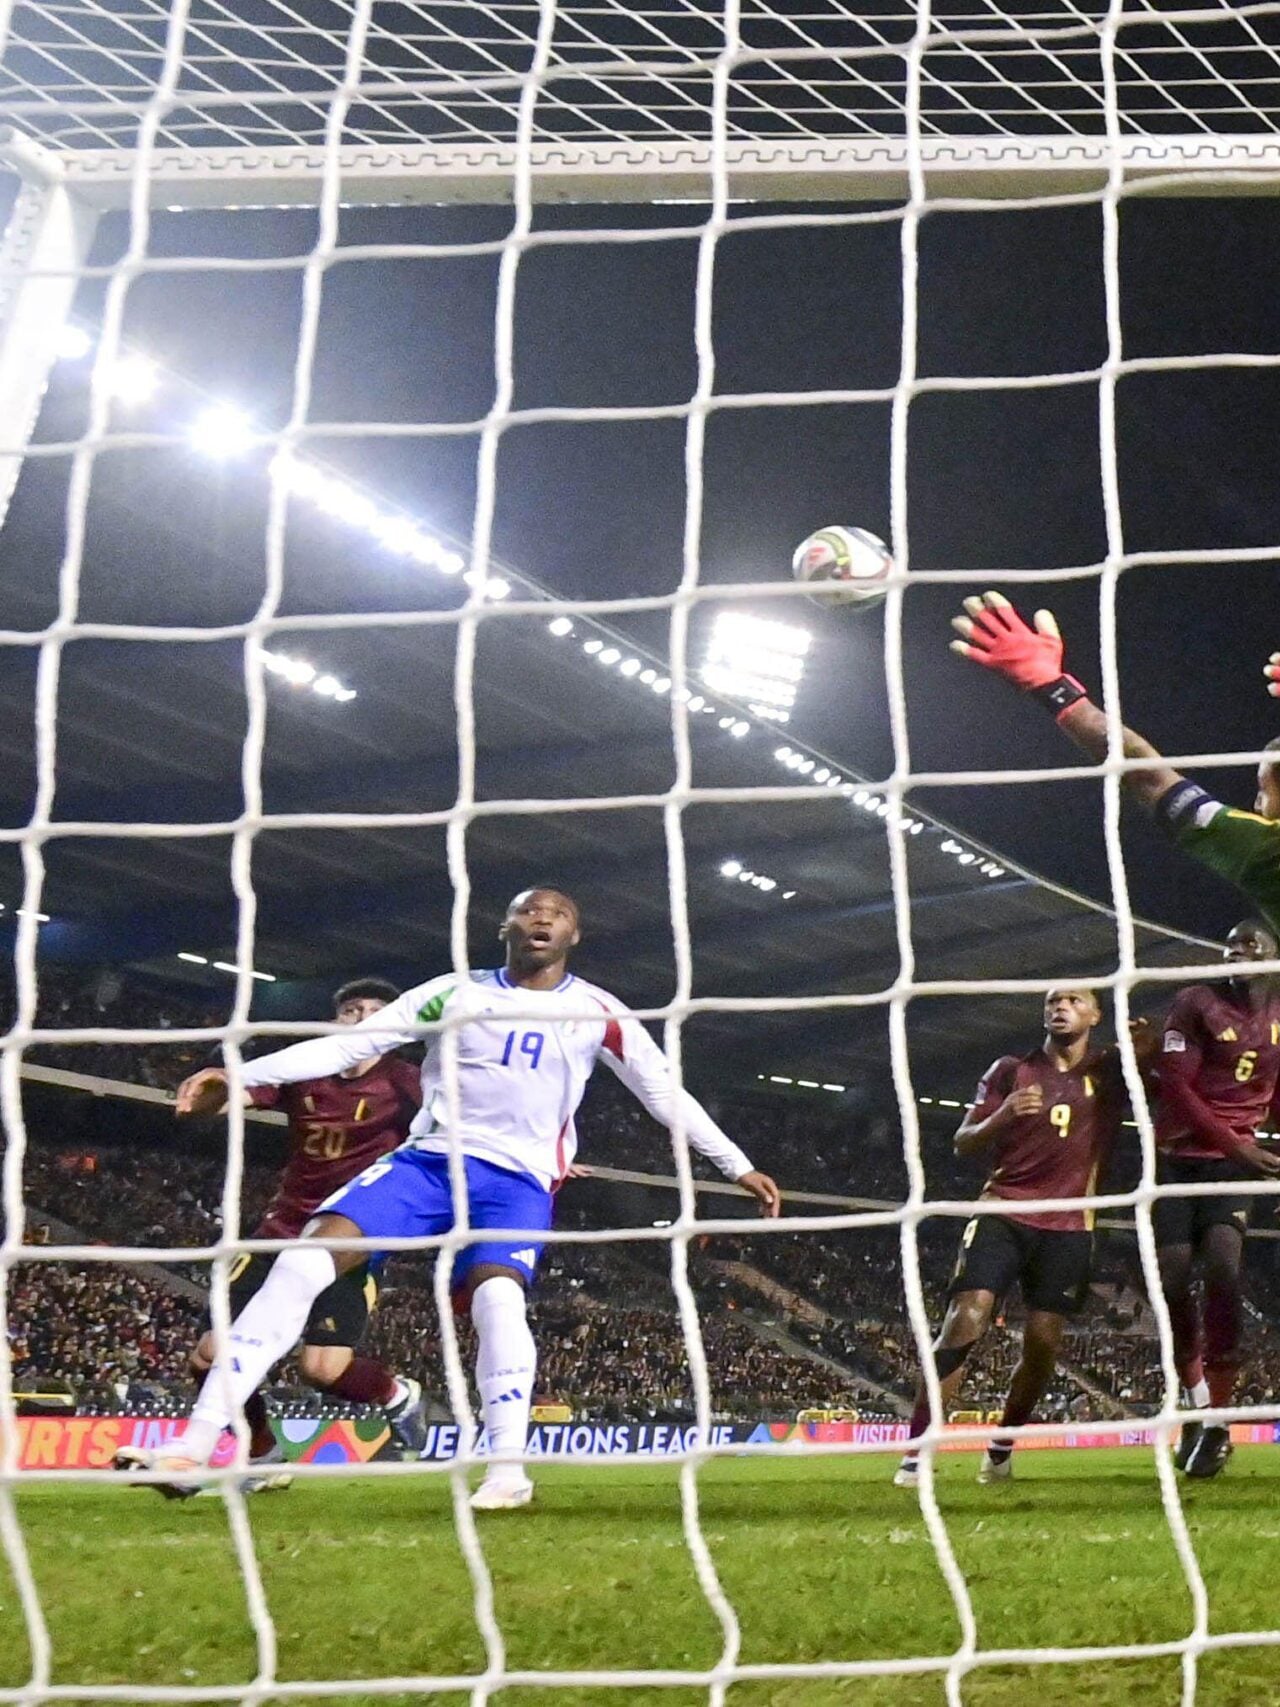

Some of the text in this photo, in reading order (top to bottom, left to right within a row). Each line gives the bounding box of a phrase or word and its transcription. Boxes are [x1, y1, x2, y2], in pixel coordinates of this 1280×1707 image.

[501, 1031, 545, 1069] 19
[1235, 1050, 1258, 1082] 6
[1050, 1103, 1072, 1138] 9
[303, 1123, 346, 1160] 20
[963, 1218, 979, 1250] 9
[525, 1424, 630, 1455] ATIONS
